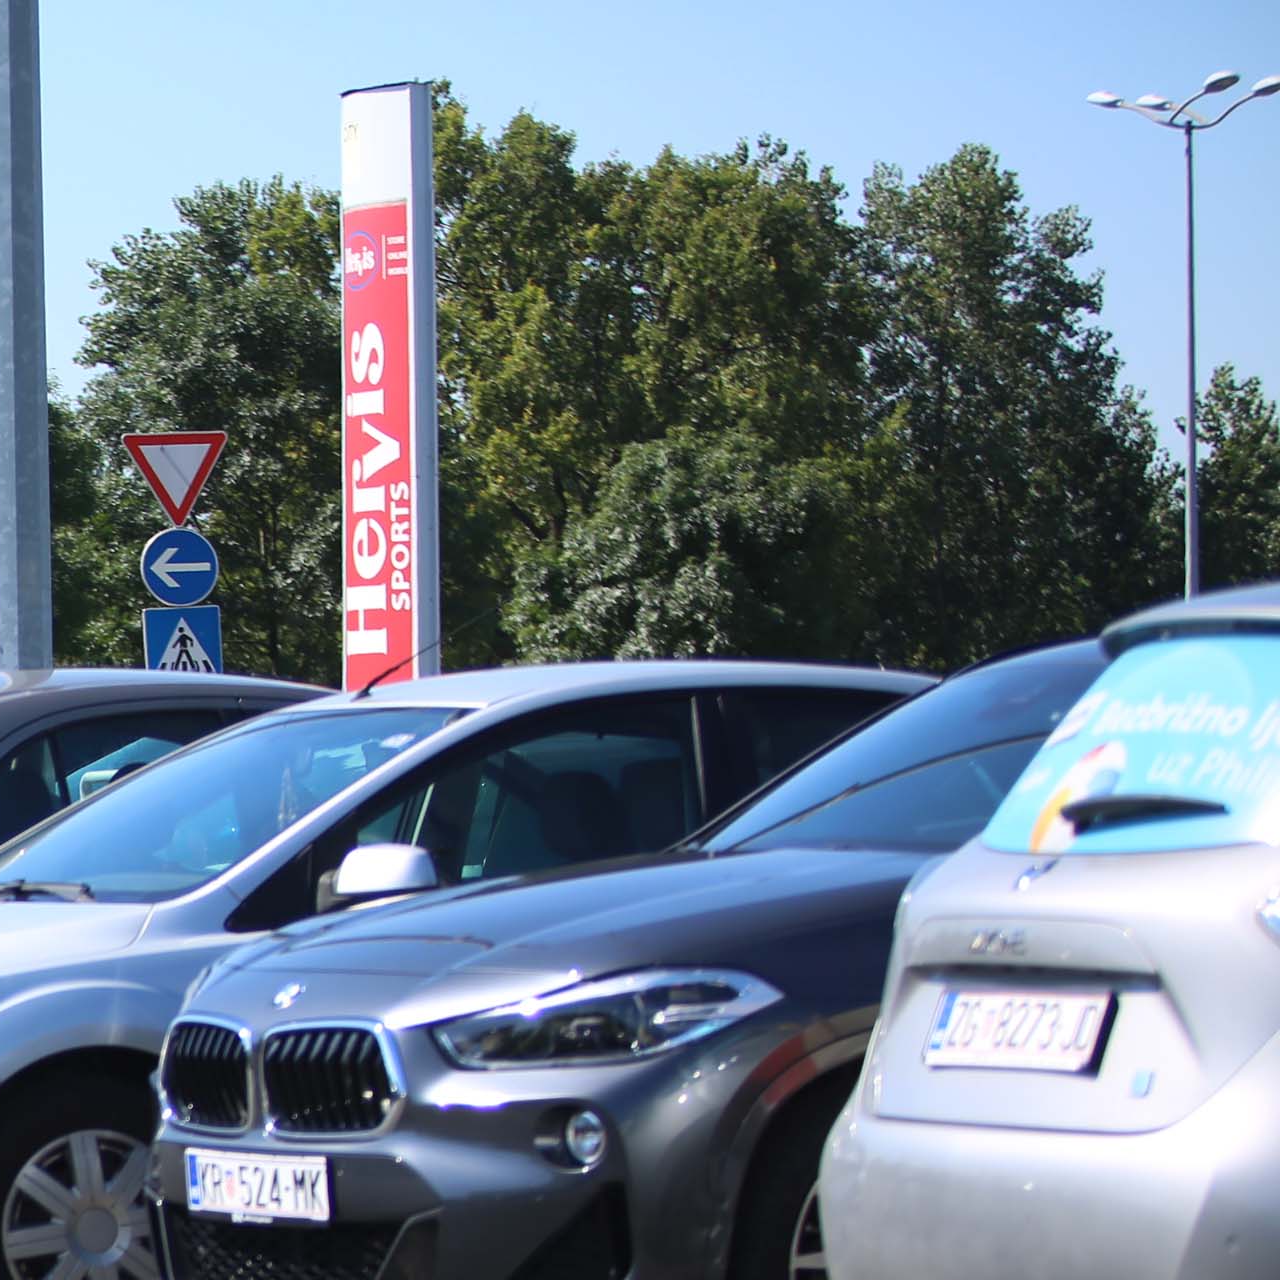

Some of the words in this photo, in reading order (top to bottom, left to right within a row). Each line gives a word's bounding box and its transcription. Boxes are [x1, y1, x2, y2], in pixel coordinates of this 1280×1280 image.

[346, 322, 401, 656] Hervis
[390, 481, 411, 612] SPORTS
[947, 1001, 981, 1047] ZG
[201, 1163, 224, 1204] KR
[239, 1165, 322, 1213] 524-MK
